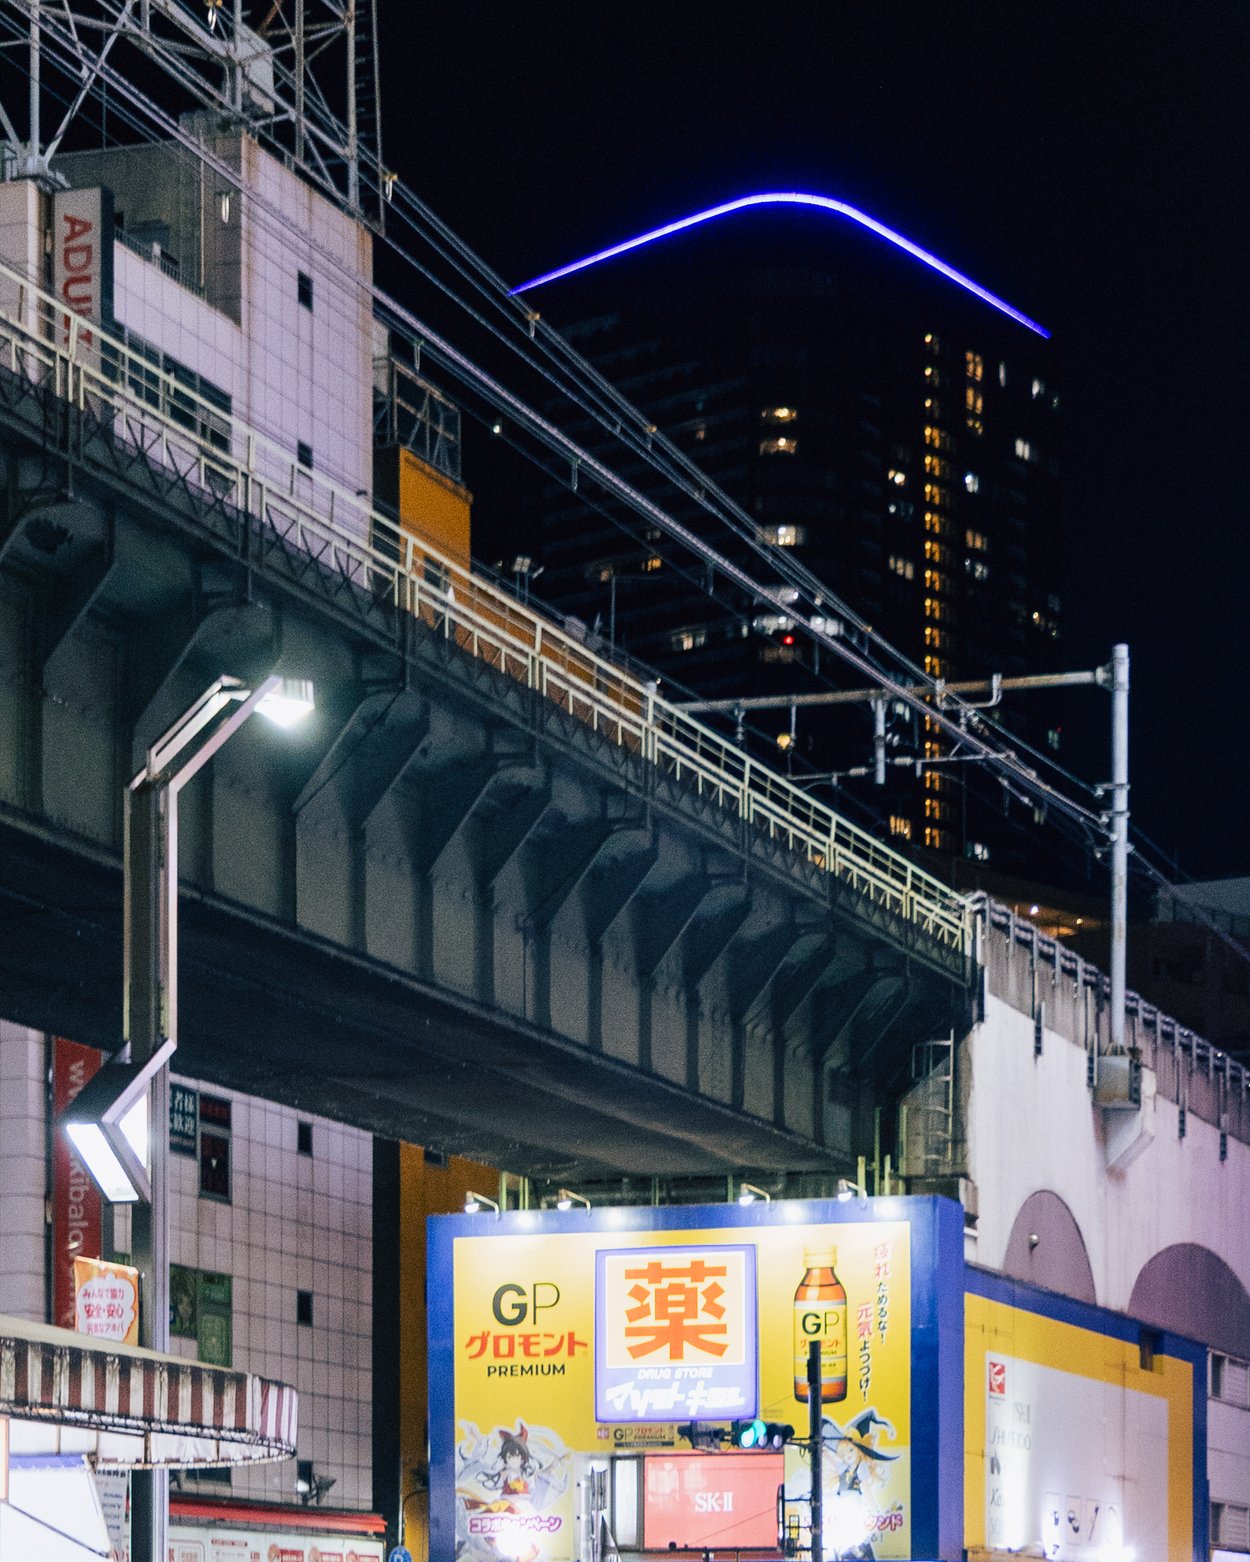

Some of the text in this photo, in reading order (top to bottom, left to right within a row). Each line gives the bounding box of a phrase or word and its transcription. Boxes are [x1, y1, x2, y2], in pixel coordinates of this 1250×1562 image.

[492, 1282, 561, 1326] GP
[625, 1260, 729, 1360] 薬
[802, 1312, 840, 1335] GP
[465, 1331, 588, 1360] グロモント
[487, 1363, 566, 1378] PREMIUM
[637, 1367, 714, 1380] DRUG STORE
